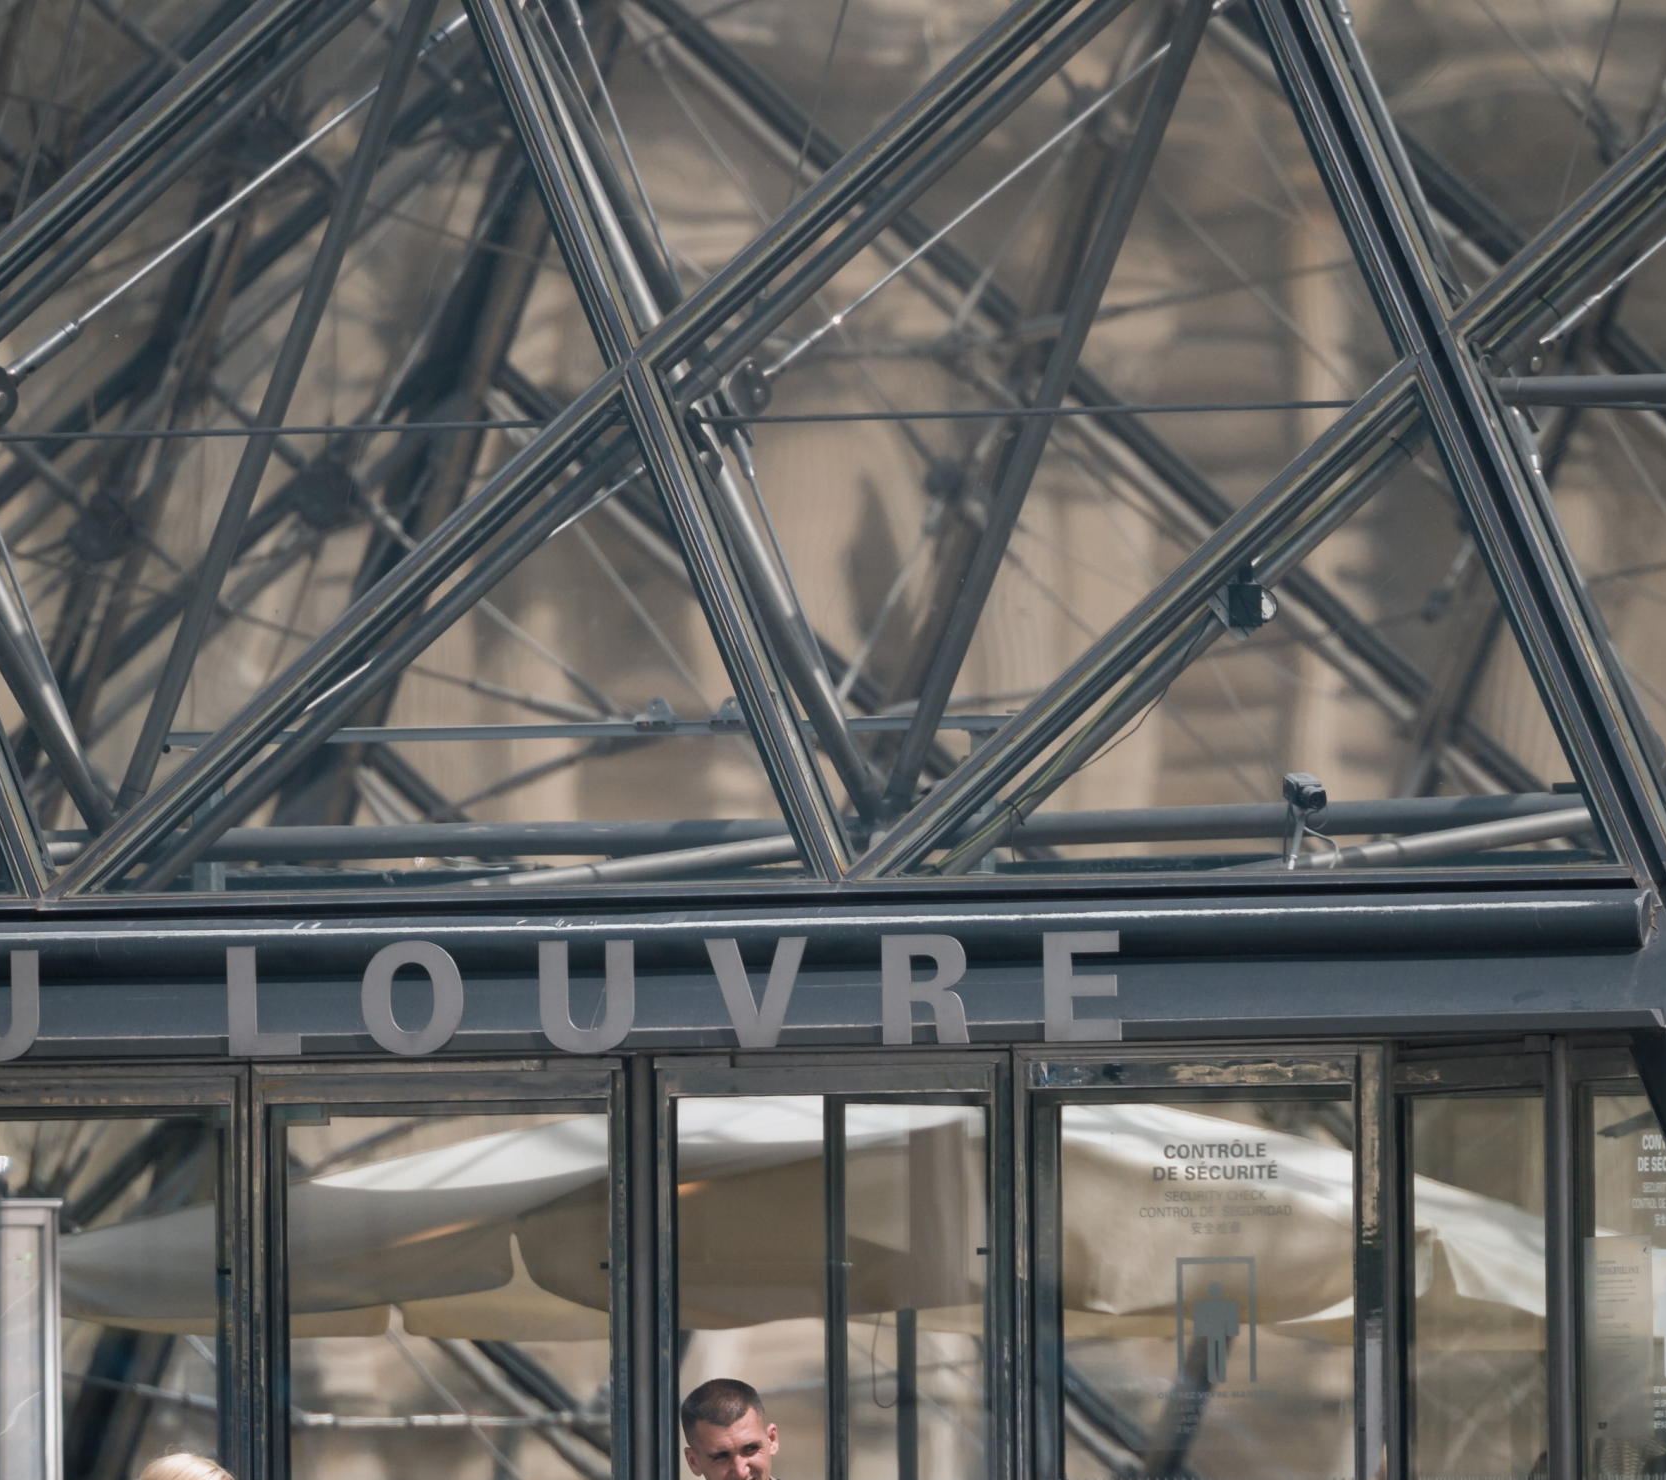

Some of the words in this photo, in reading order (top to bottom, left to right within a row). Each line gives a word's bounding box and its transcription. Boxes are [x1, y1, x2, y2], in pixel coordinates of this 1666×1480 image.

[225, 930, 1123, 1056] LOUVRE
[1163, 1139, 1267, 1159] CONTRÔLE
[1152, 1166, 1178, 1181] DE
[1184, 1160, 1278, 1181] SÉCURITÉ
[1637, 1156, 1650, 1172] DE
[1164, 1190, 1222, 1202] SECURITY
[1226, 1189, 1267, 1201] CHECK
[1139, 1207, 1196, 1218] CONTROL
[1199, 1206, 1214, 1217] DE
[1222, 1205, 1293, 1217] SEGURIDAD
